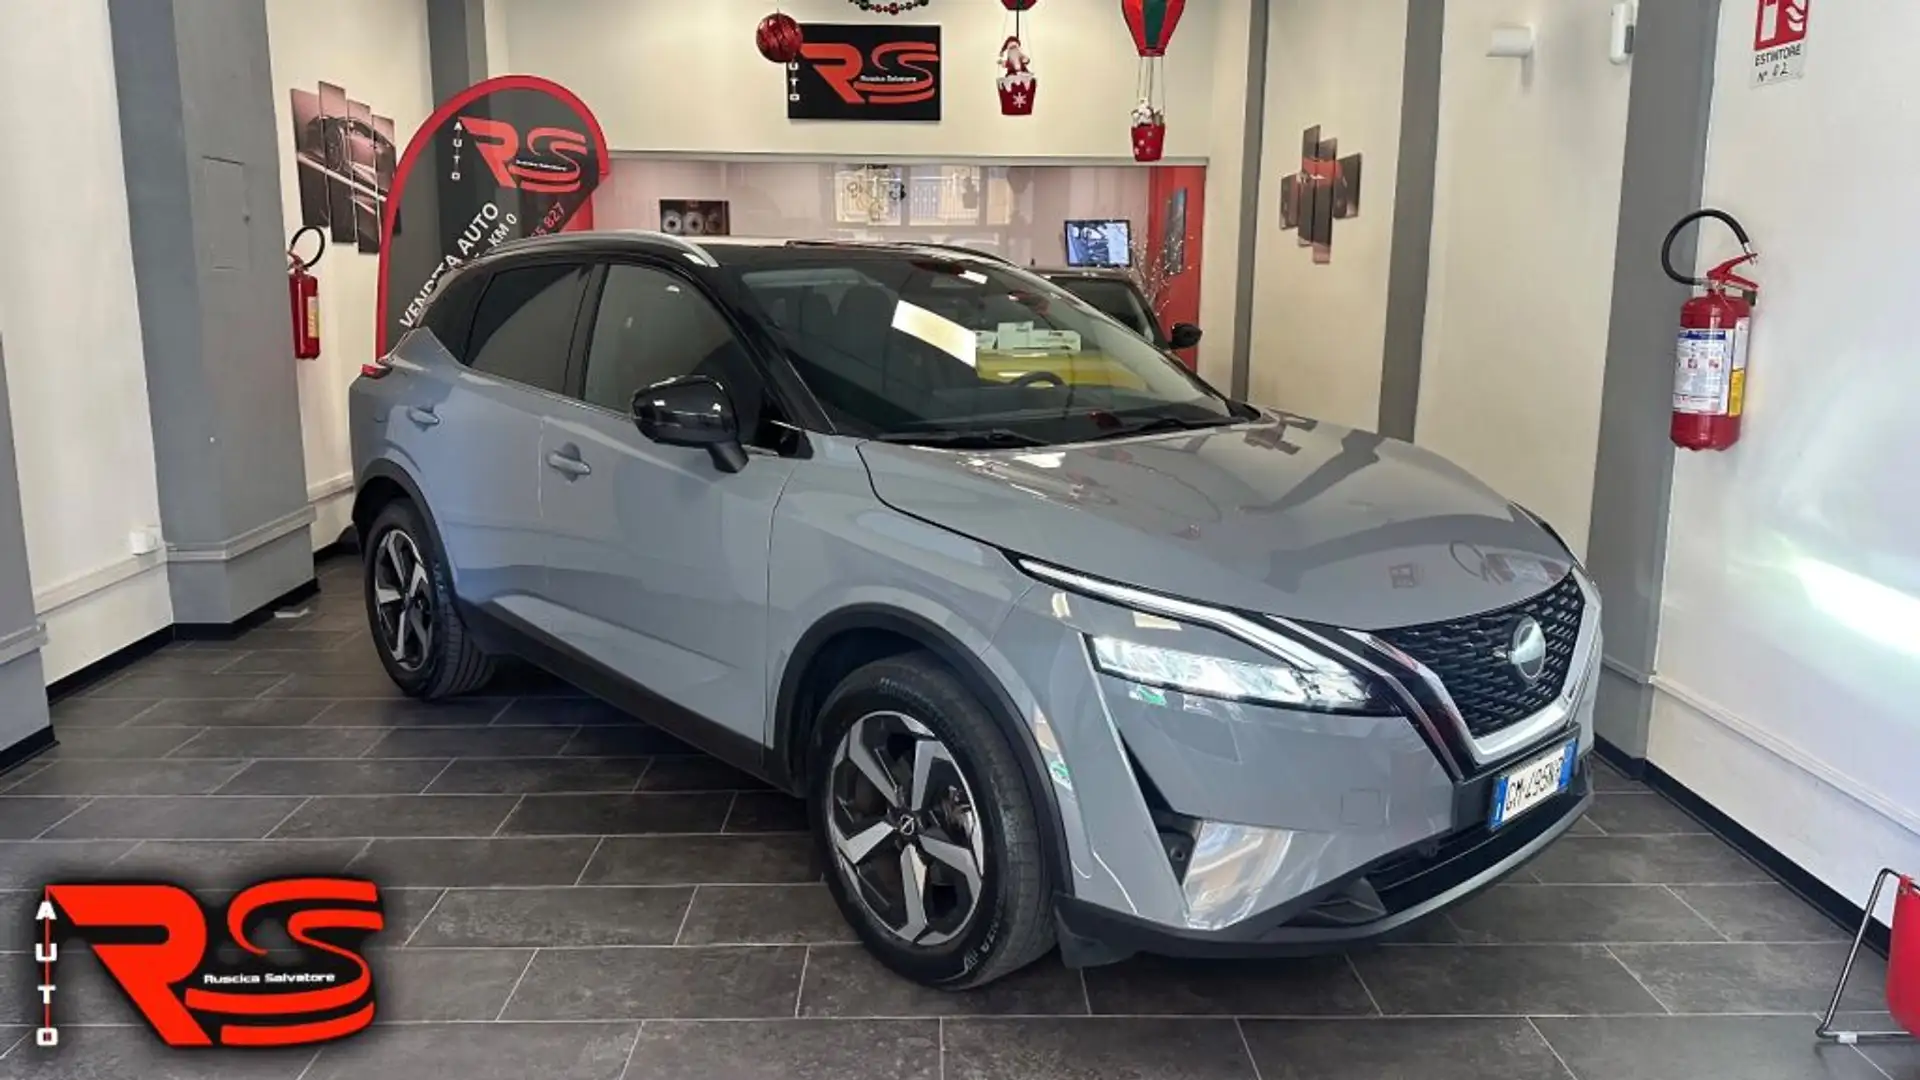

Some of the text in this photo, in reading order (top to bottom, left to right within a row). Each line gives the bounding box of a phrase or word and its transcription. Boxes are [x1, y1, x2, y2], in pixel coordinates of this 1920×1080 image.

[801, 41, 939, 104] RS
[1755, 43, 1800, 66] ESTINTORE
[788, 62, 800, 101] UTO
[451, 121, 463, 180] AUTO
[459, 116, 588, 193] RS
[457, 202, 499, 255] AUTO
[487, 223, 510, 248] KM
[543, 202, 565, 227] 827
